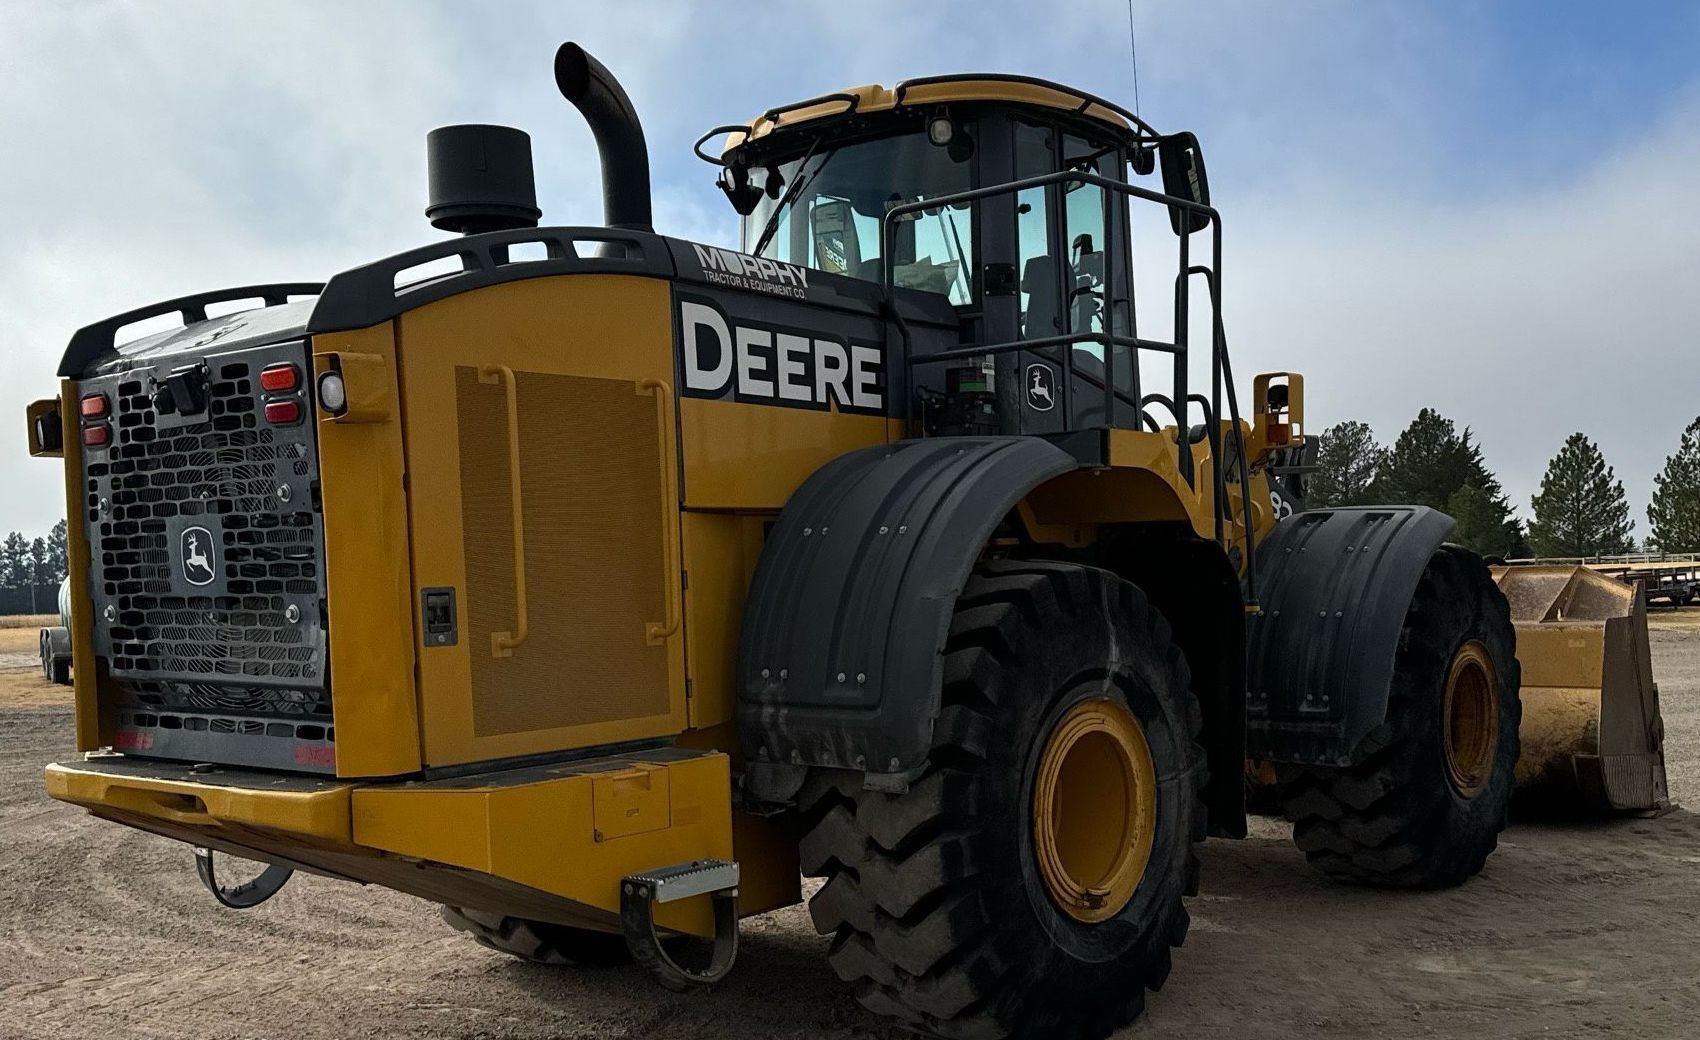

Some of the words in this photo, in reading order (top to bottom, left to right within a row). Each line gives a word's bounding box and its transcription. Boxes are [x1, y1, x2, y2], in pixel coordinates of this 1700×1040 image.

[692, 243, 809, 288] MURPHY
[703, 270, 741, 288] TRACTOR
[743, 277, 749, 289] &
[750, 281, 793, 297] EQUIPMENT
[793, 288, 807, 300] CO.
[681, 301, 882, 409] DEERE
